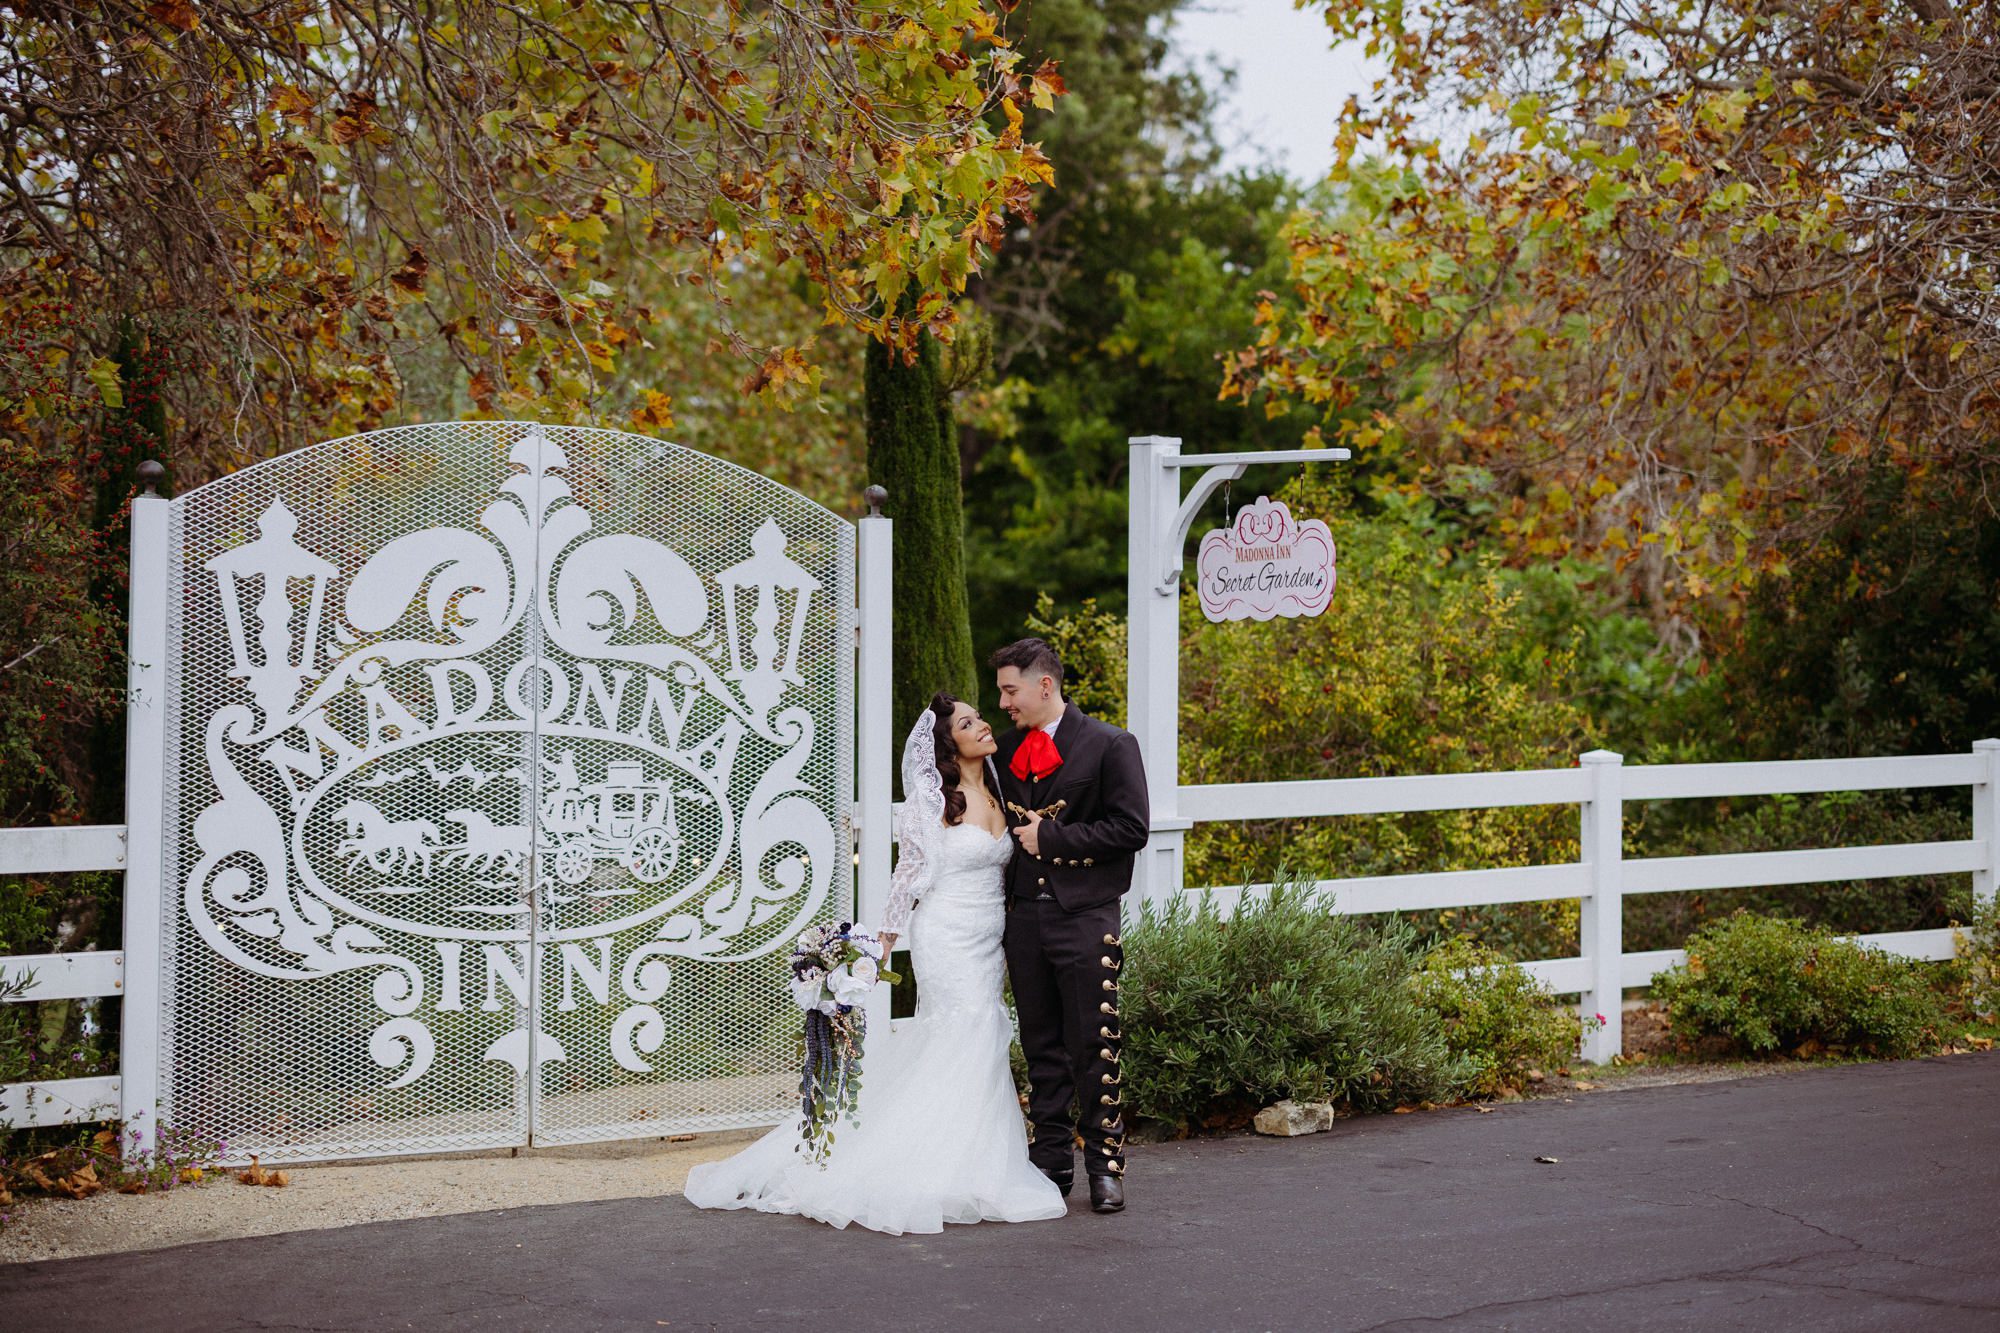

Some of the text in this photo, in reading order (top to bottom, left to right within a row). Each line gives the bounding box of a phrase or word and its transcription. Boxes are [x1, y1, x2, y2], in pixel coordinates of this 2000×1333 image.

[1212, 562, 1314, 595] Secret Garden
[1236, 543, 1290, 563] MADONNA INN
[258, 658, 747, 812] MADONNA
[435, 938, 614, 1012] INN
